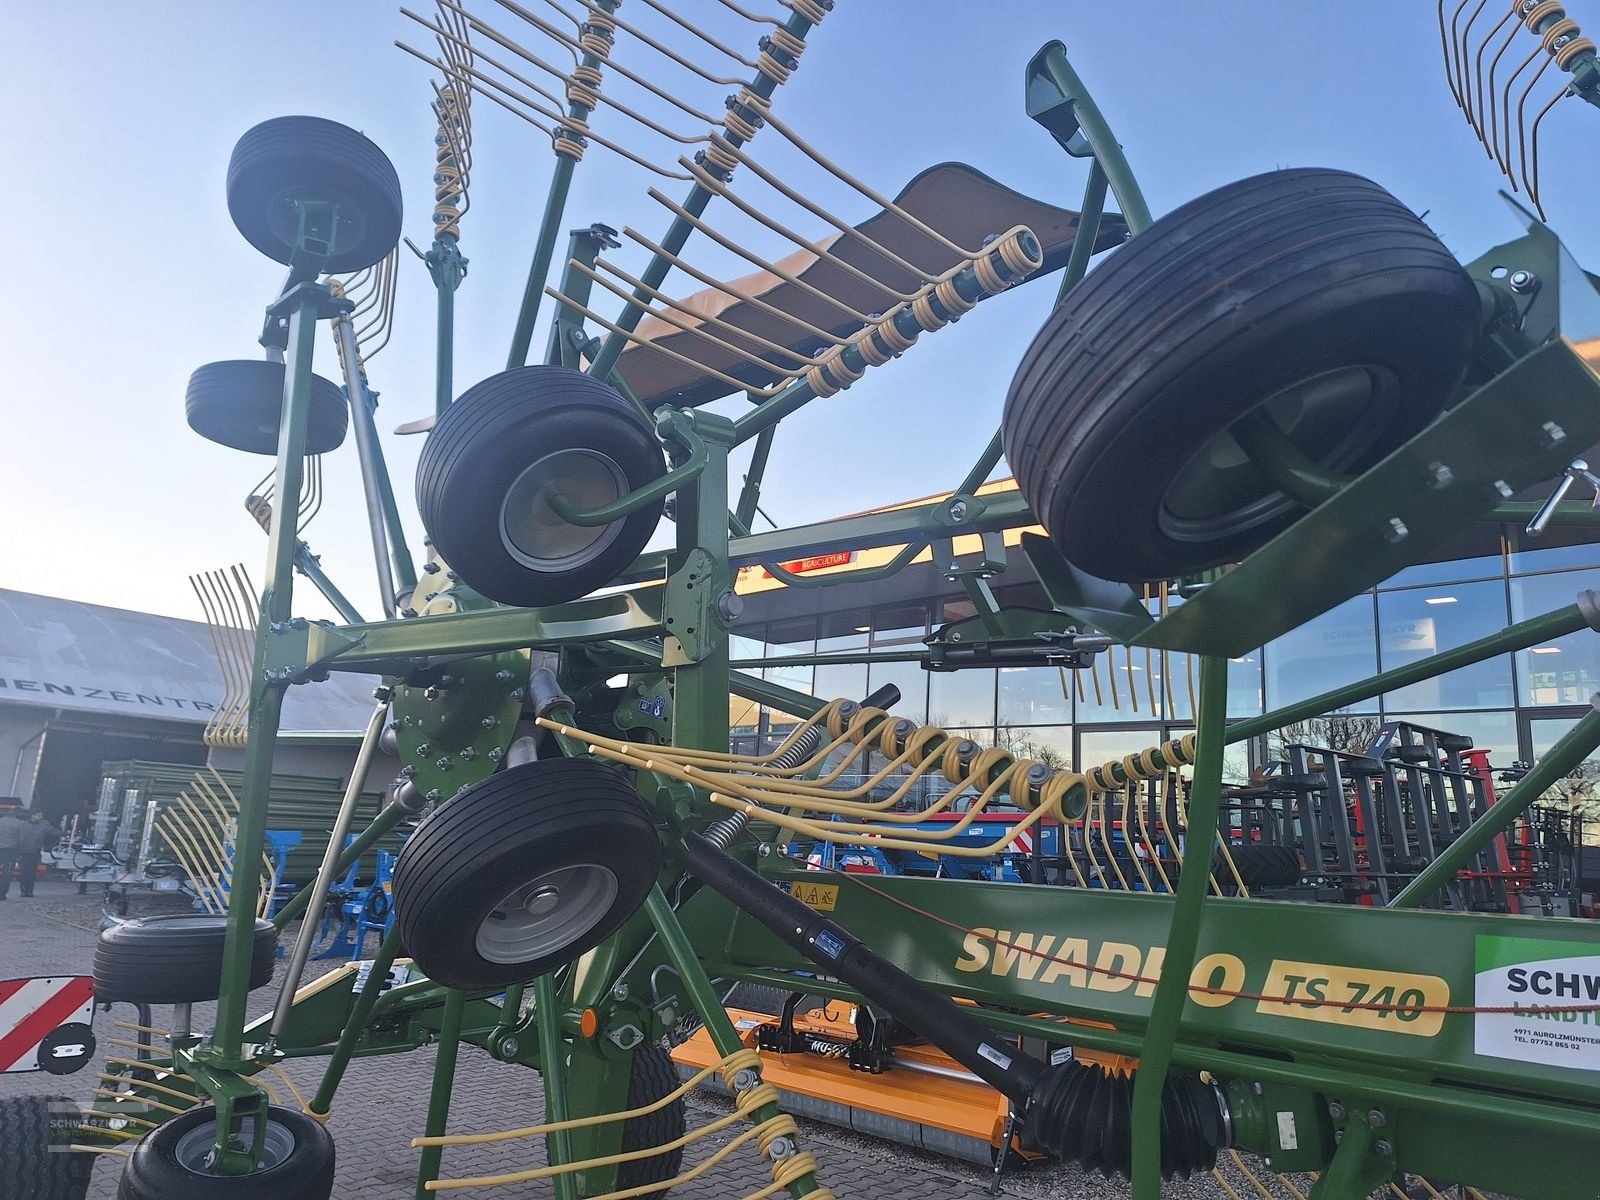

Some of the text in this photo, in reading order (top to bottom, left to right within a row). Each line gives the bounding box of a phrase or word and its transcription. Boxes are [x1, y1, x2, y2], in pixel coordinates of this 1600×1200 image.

[802, 554, 847, 569] AGRICULTURE
[1283, 974, 1426, 1022] TS 740
[1514, 1028, 1531, 1036] 4971
[1530, 1038, 1553, 1047] 07752
